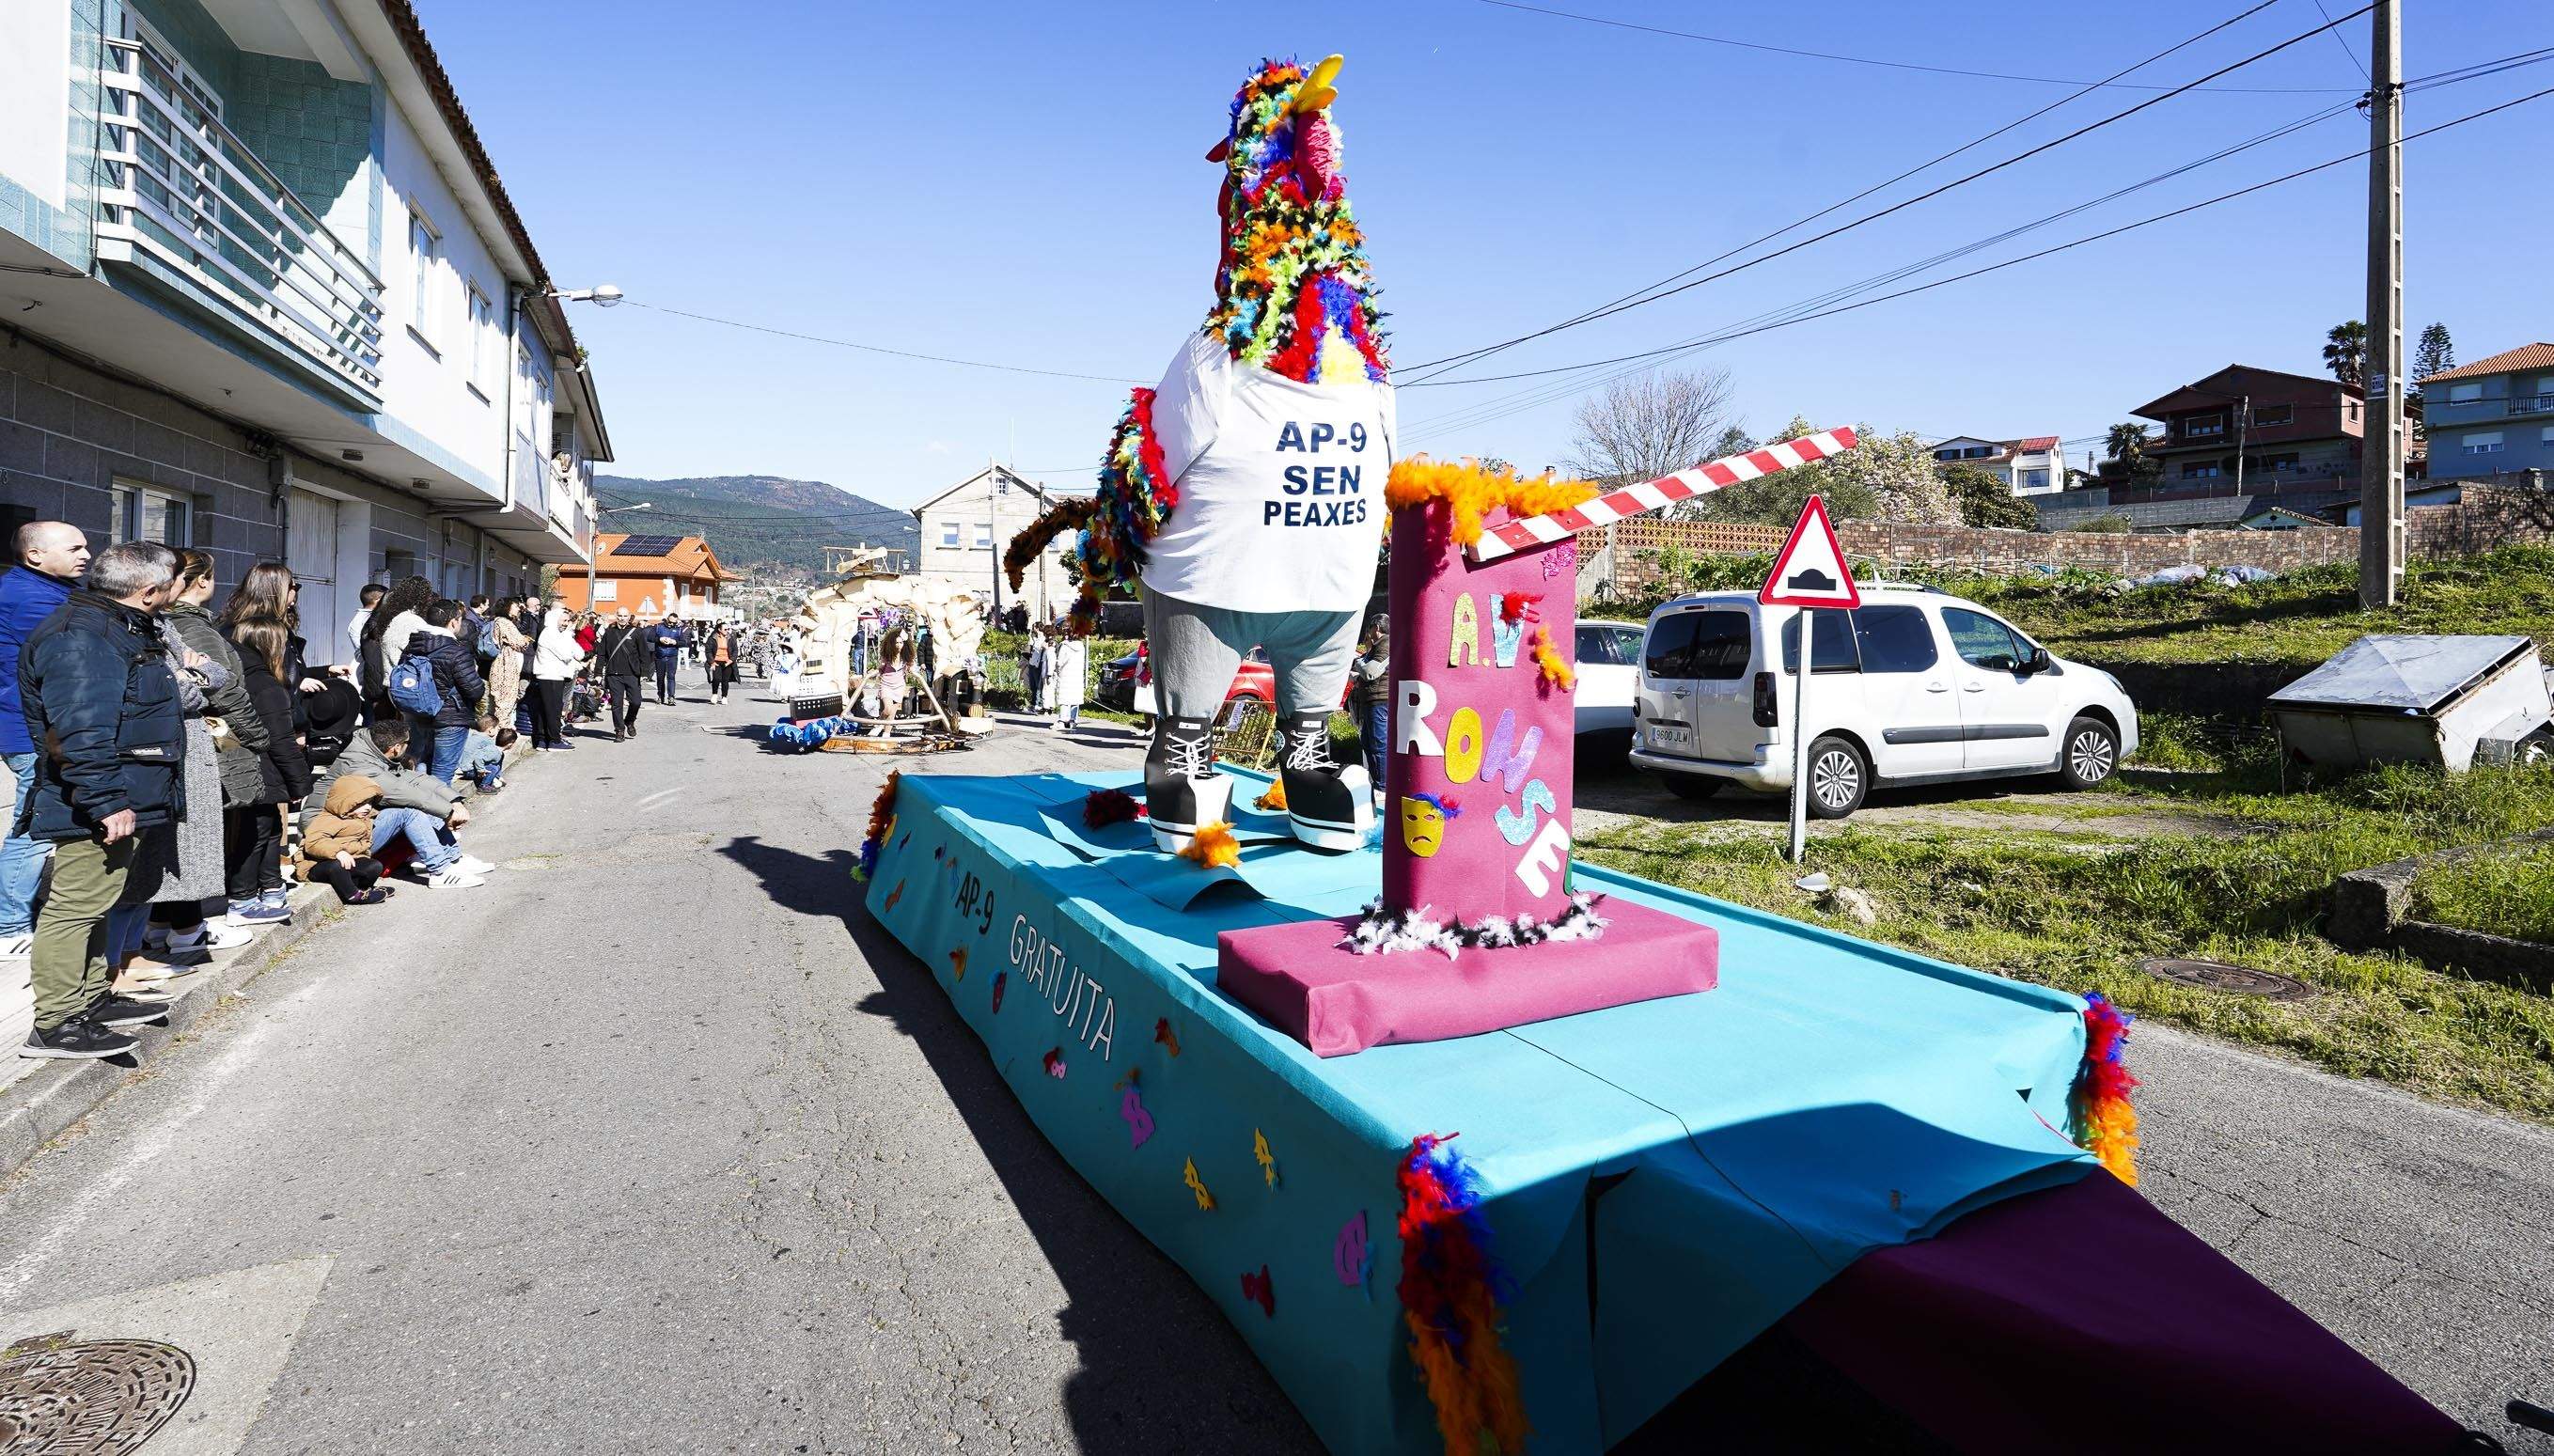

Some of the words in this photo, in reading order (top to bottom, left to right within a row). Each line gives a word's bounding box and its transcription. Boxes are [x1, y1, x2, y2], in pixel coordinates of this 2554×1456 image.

[1275, 421, 1368, 453] AP-9
[1282, 465, 1361, 495] SEN
[1263, 498, 1367, 527] PEAXES
[1655, 729, 1673, 742] 9600
[955, 871, 995, 934] AP-9
[1010, 914, 1115, 1061] GRATUITA
